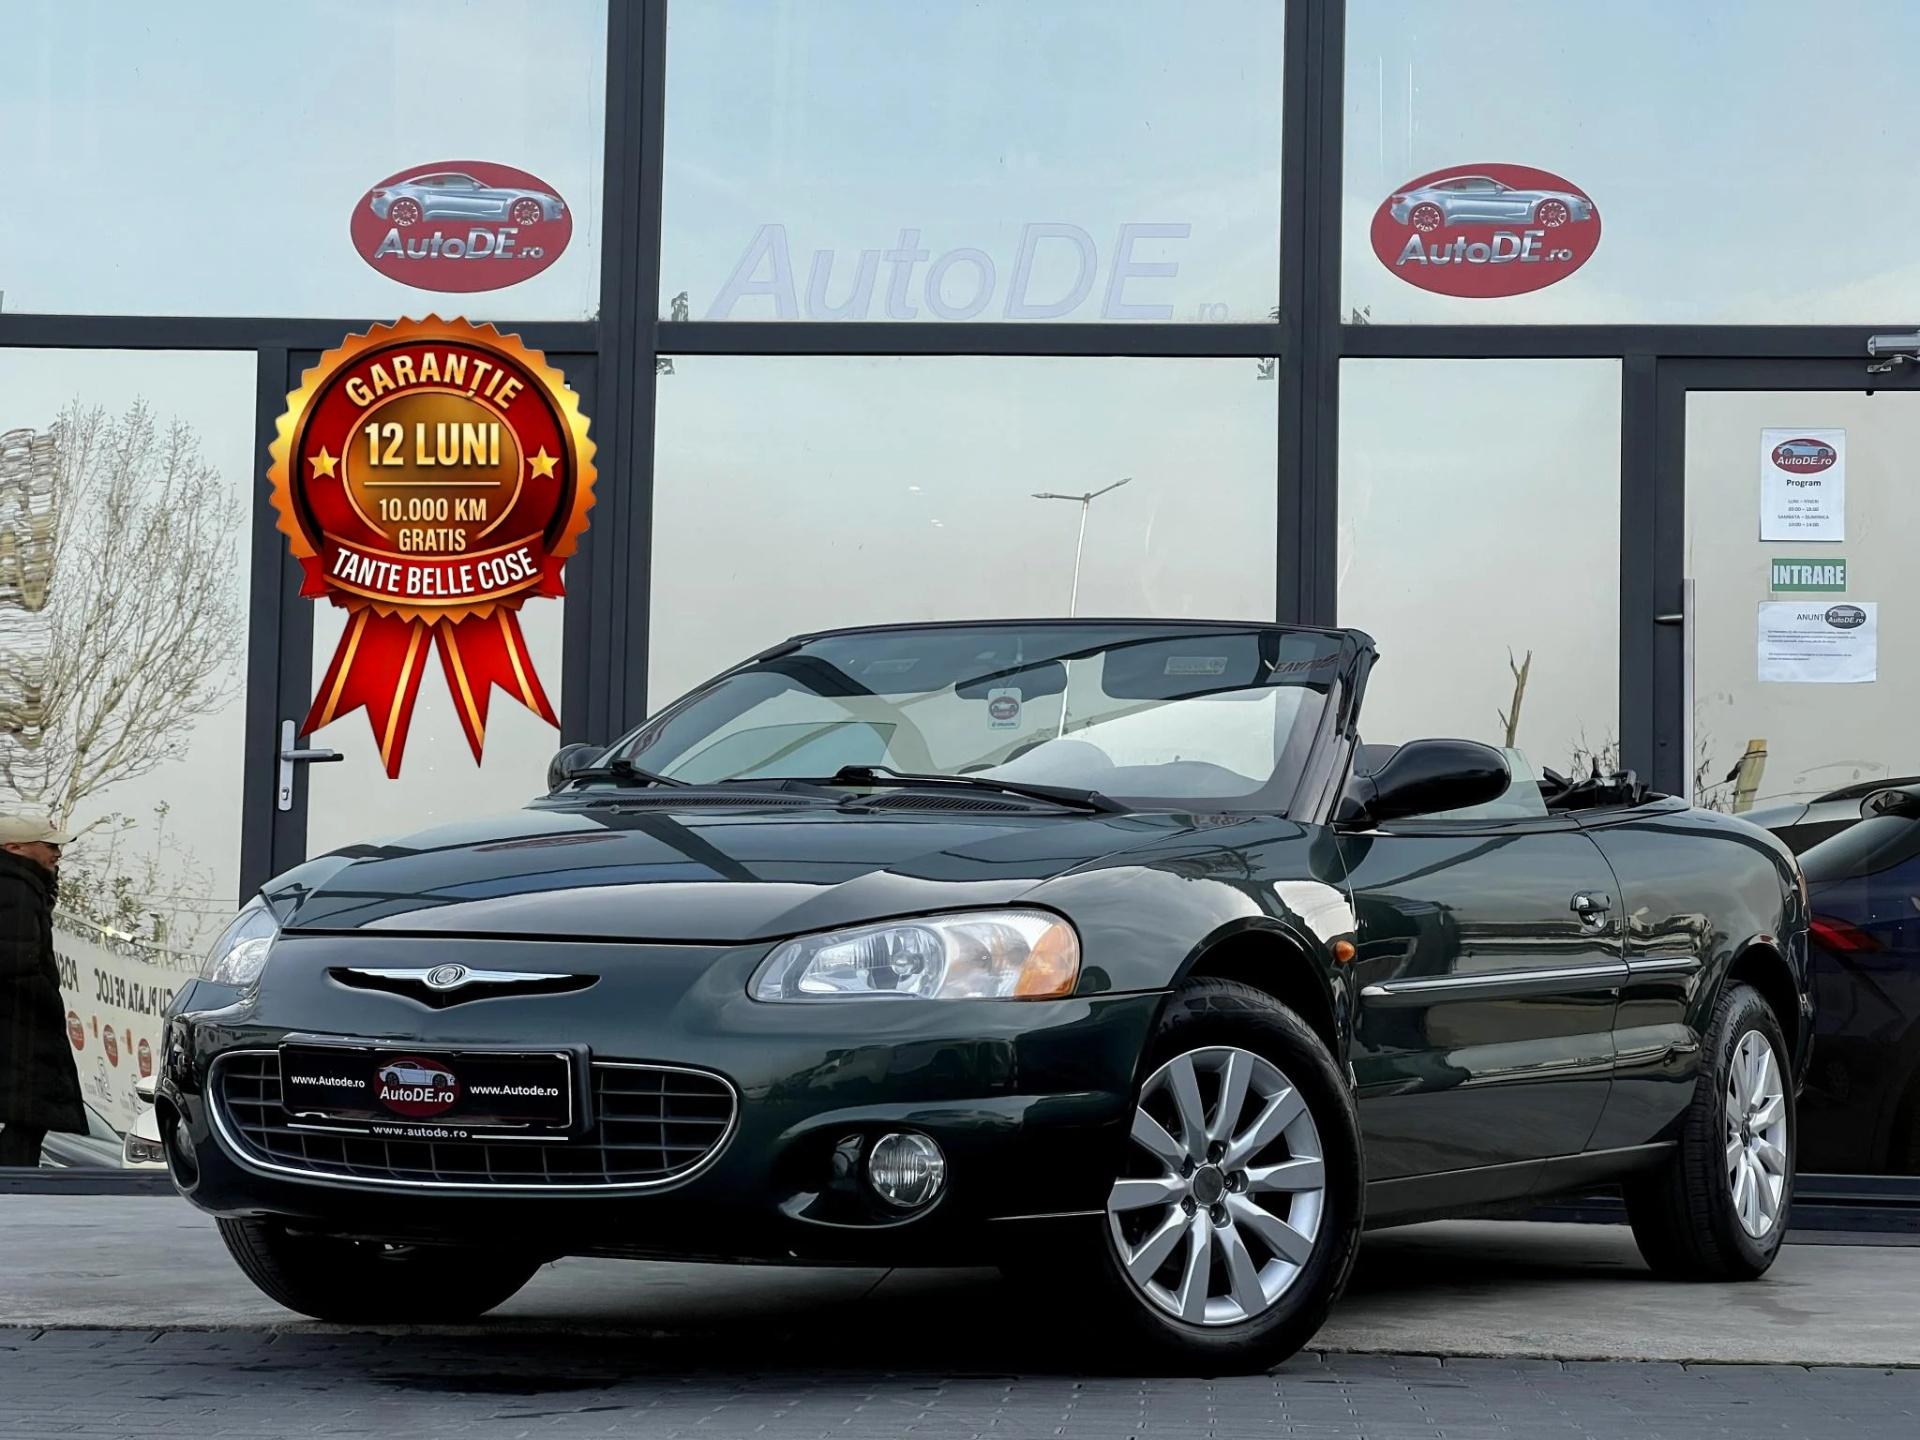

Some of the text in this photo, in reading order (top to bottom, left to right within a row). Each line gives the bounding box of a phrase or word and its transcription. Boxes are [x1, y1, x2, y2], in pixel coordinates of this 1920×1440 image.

[1776, 456, 1832, 466] AutoDE.ro
[1786, 479, 1822, 488] Program
[1773, 565, 1845, 585] INTRARE
[291, 1075, 365, 1088] www.Autode.ro
[379, 1086, 454, 1103] AutoDE.ro
[470, 1084, 558, 1097] www.Autode.ro
[373, 1125, 467, 1138] www.autode.ro
